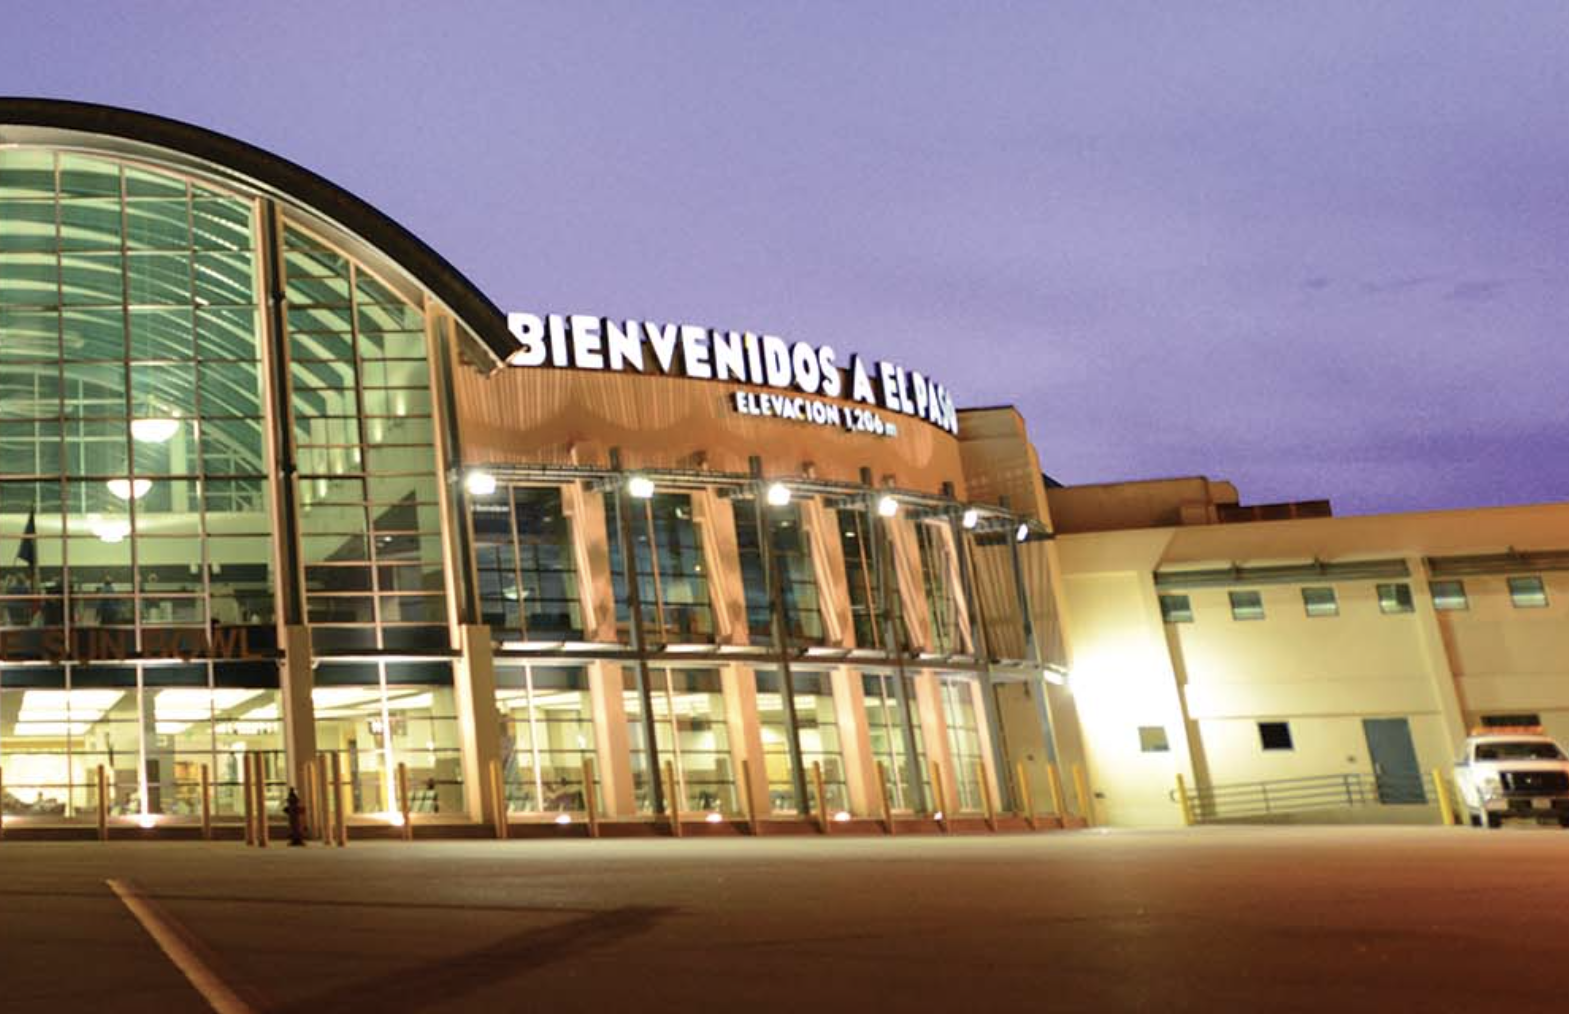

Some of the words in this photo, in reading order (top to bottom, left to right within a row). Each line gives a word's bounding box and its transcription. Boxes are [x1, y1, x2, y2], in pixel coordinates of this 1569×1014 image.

[507, 313, 841, 397] BIENVENIDOS
[853, 355, 877, 405] A
[880, 361, 916, 415] EL
[736, 391, 840, 425] ELEVACION
[40, 628, 128, 666] SUN
